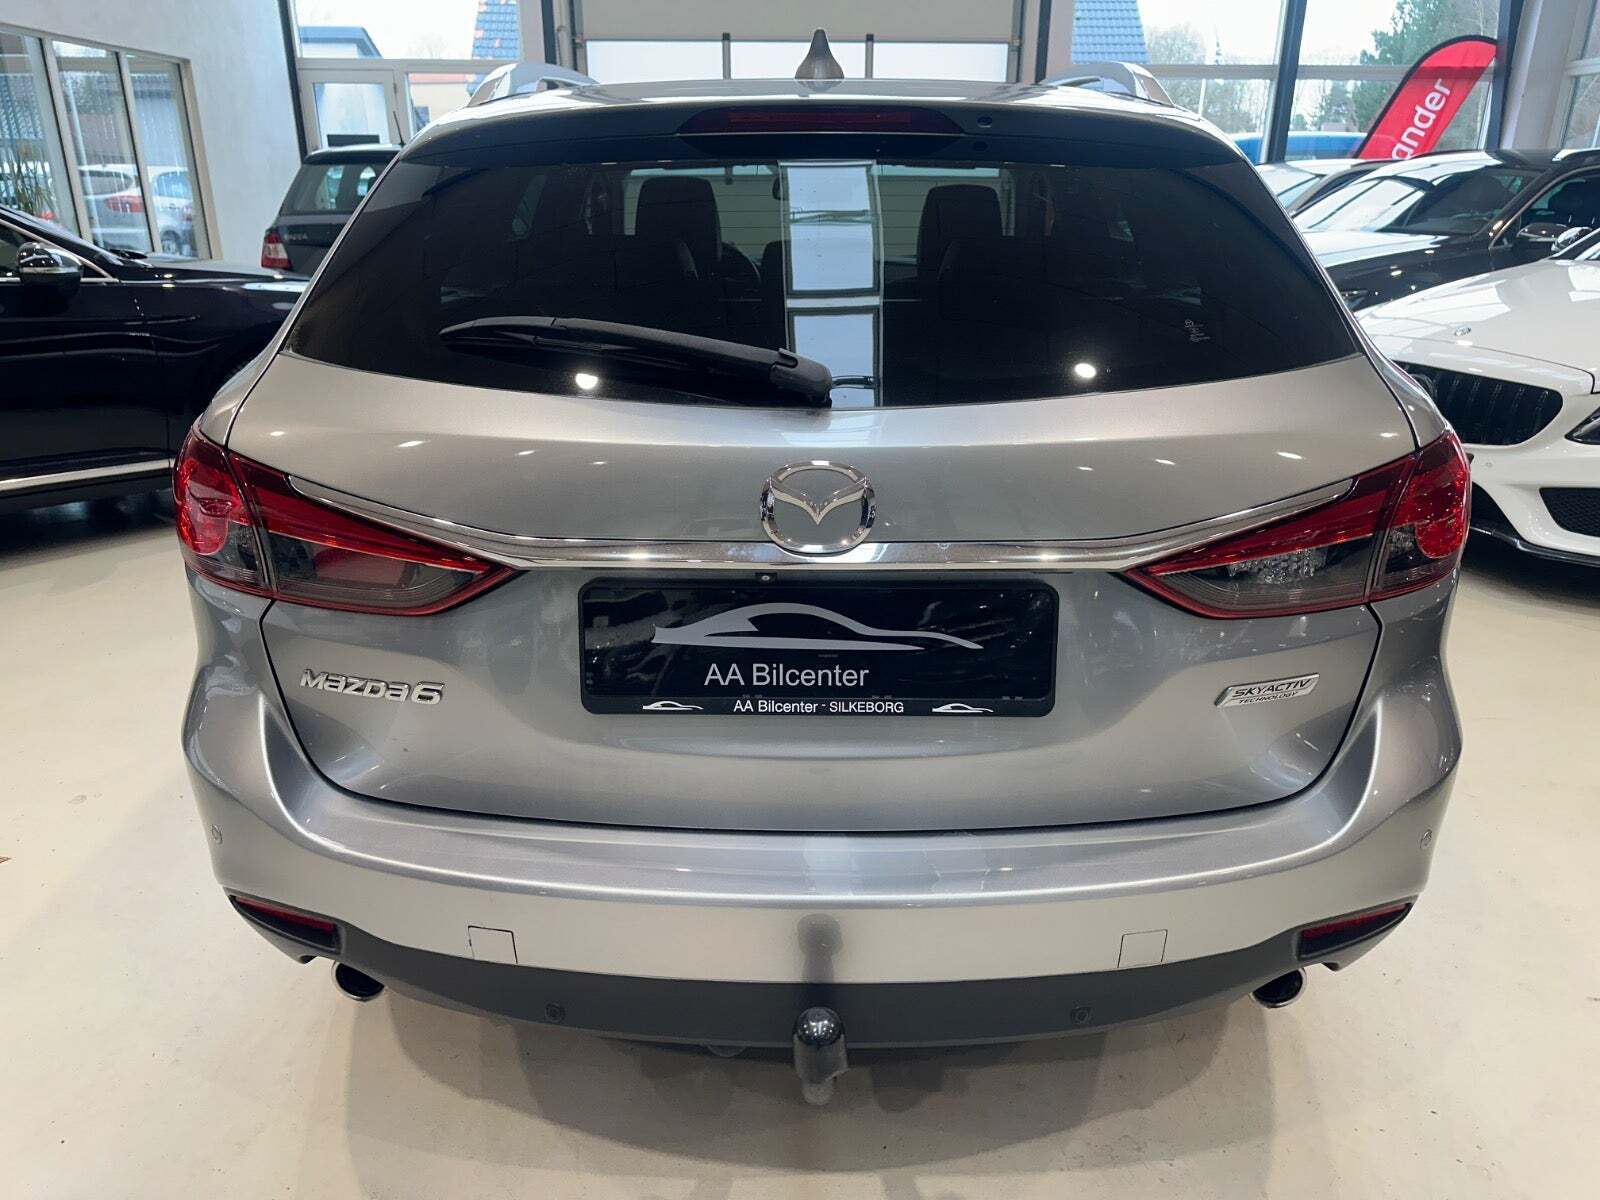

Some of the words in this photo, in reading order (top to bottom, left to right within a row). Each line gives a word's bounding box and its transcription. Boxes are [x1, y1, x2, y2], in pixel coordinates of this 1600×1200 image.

[1392, 78, 1451, 160] ander
[704, 663, 745, 686] AA
[752, 663, 869, 687] Bilcenter
[1232, 679, 1311, 698] SKYACTIV
[1239, 691, 1298, 704] TECHNOLOGY
[733, 700, 754, 713] AA
[758, 700, 818, 713] Bilcenter
[829, 701, 905, 714] SILKEBORG
